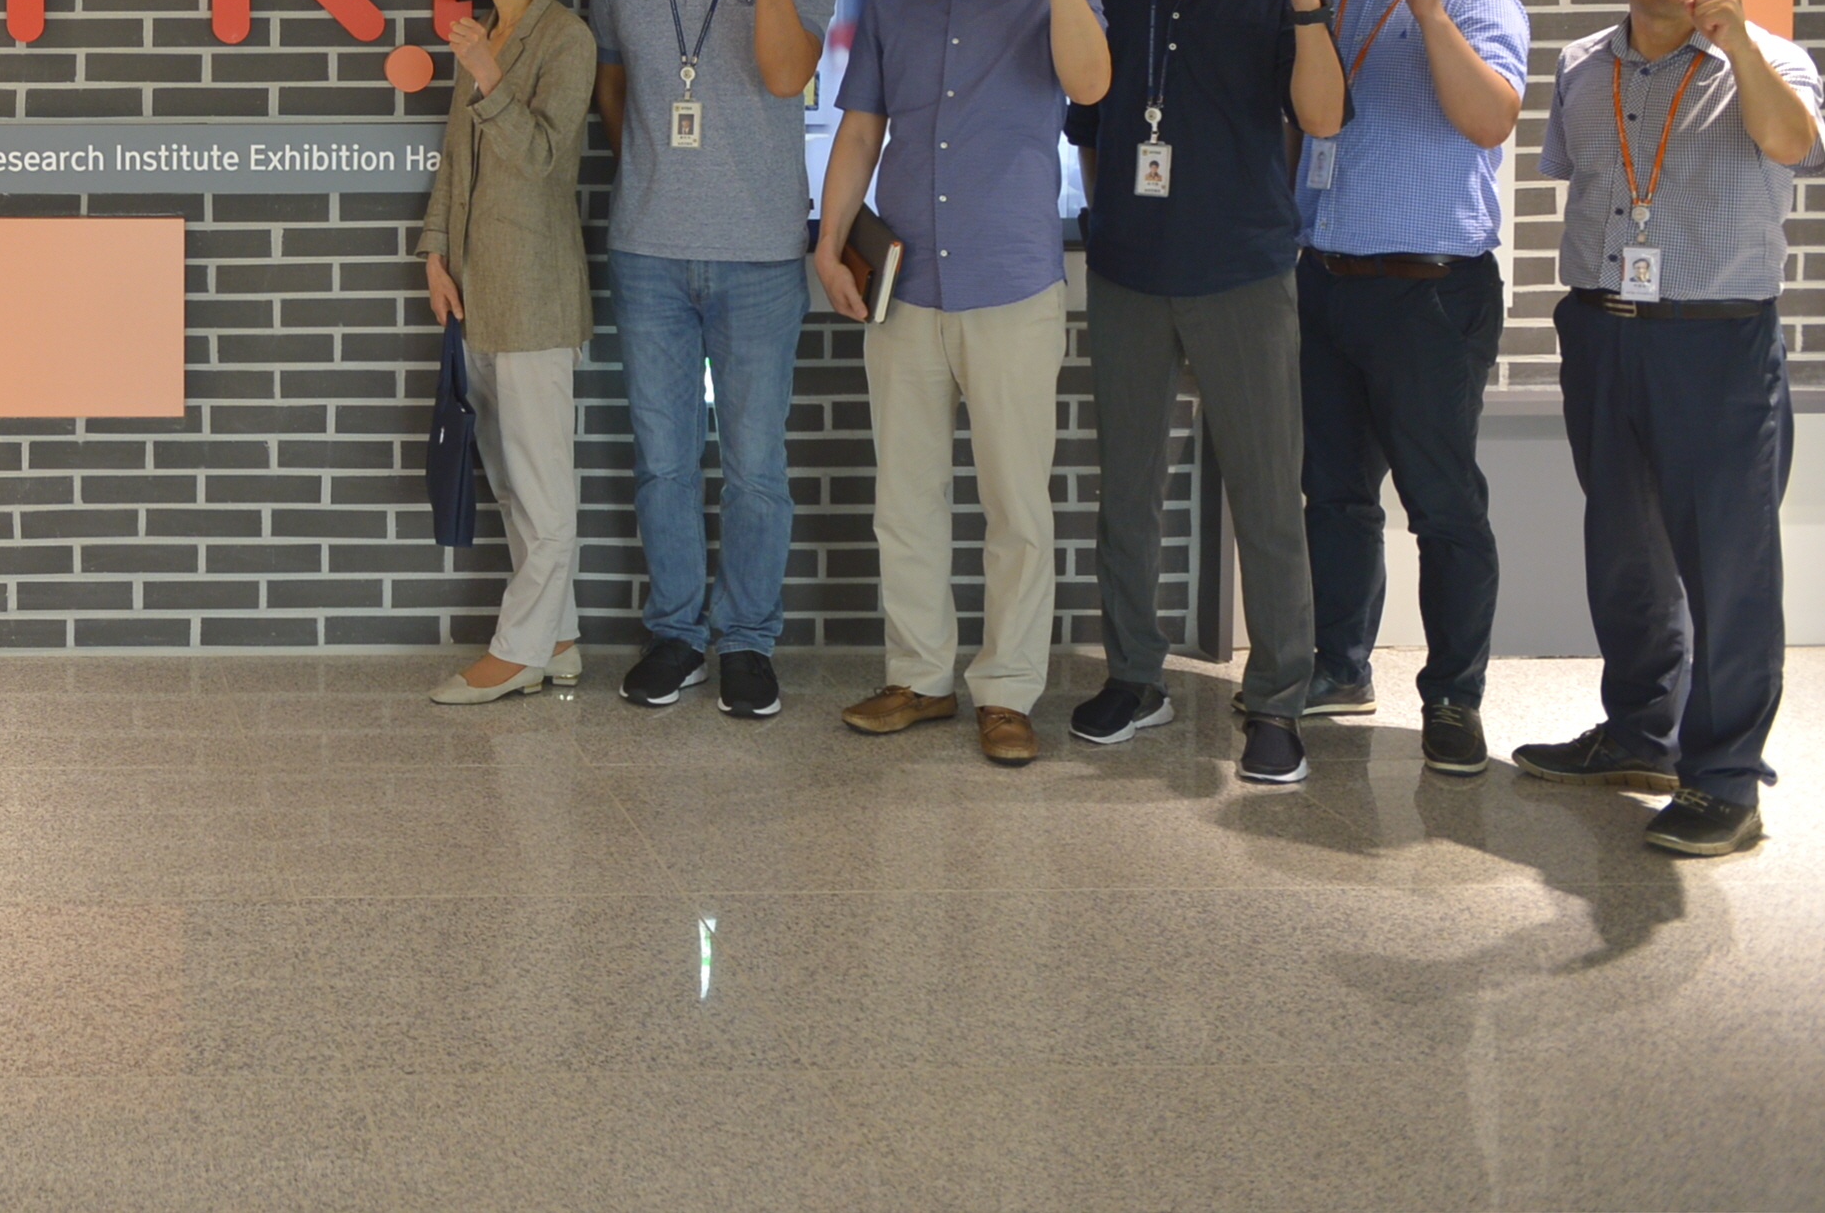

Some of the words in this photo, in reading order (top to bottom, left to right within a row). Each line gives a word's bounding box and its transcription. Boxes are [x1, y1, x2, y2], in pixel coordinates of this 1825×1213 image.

[115, 143, 240, 171] Institute
[249, 143, 395, 171] Exhibition
[405, 144, 442, 171] Ha
